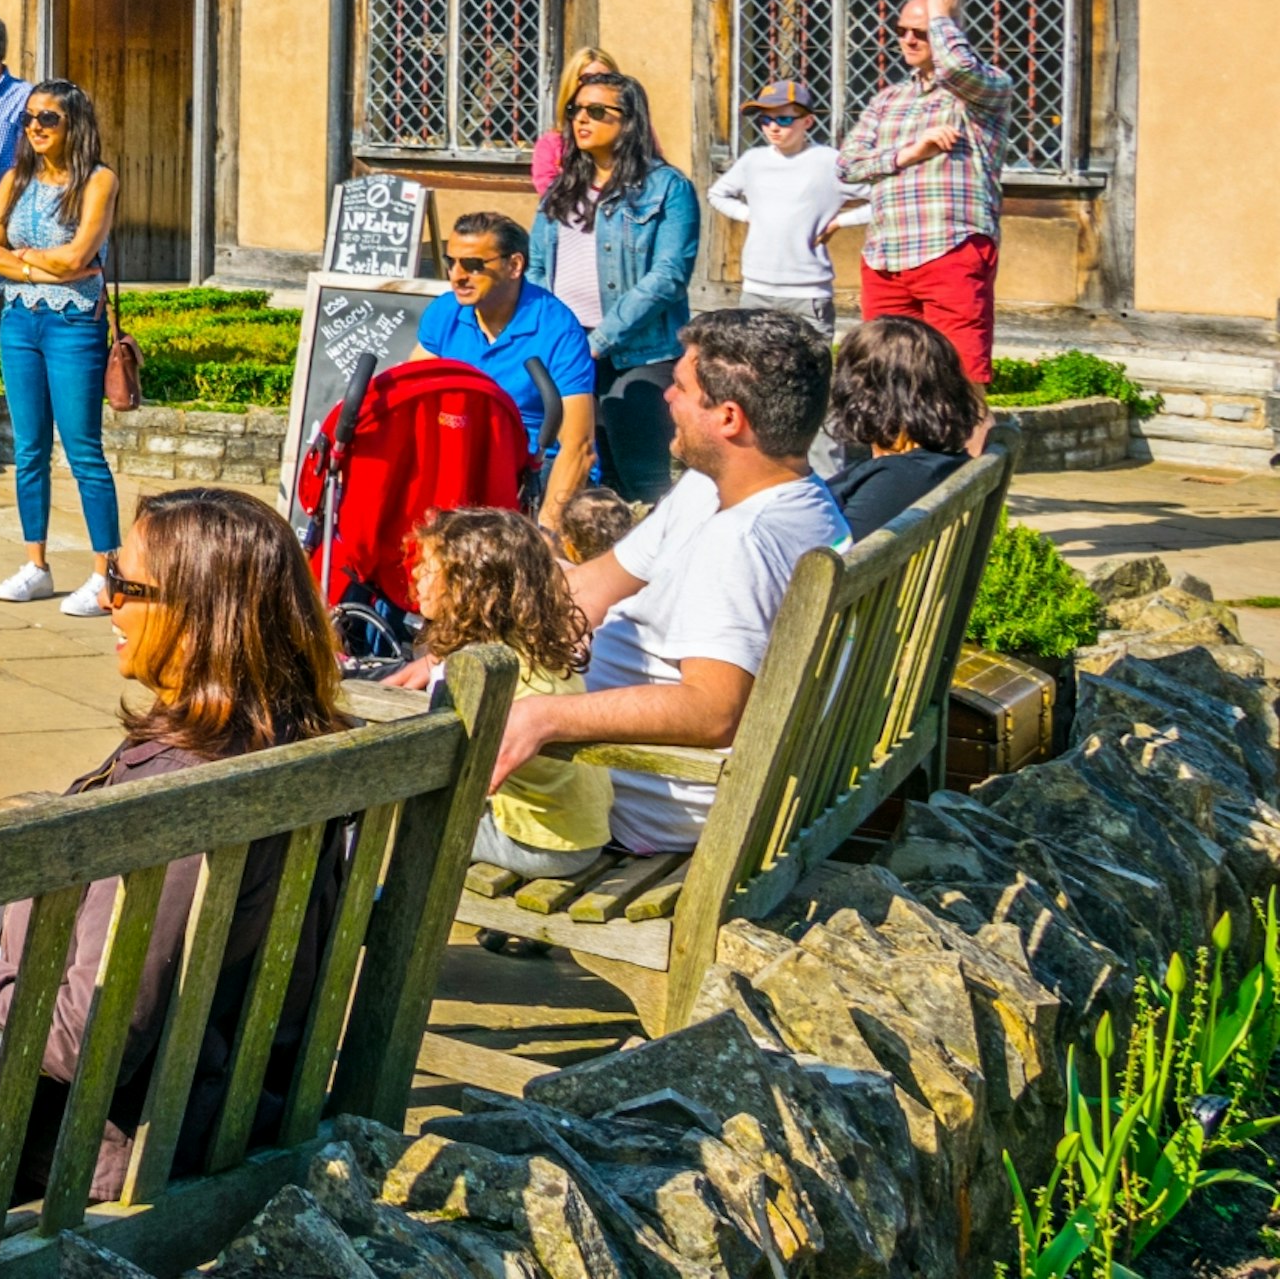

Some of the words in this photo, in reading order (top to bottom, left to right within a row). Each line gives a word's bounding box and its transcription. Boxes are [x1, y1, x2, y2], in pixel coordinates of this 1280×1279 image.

[363, 211, 409, 246] Entry
[335, 243, 379, 275] Exit
[380, 253, 408, 277] only
[326, 332, 358, 360] Henry
[357, 325, 368, 336] V
[335, 328, 378, 370] Richard
[376, 313, 391, 331] III
